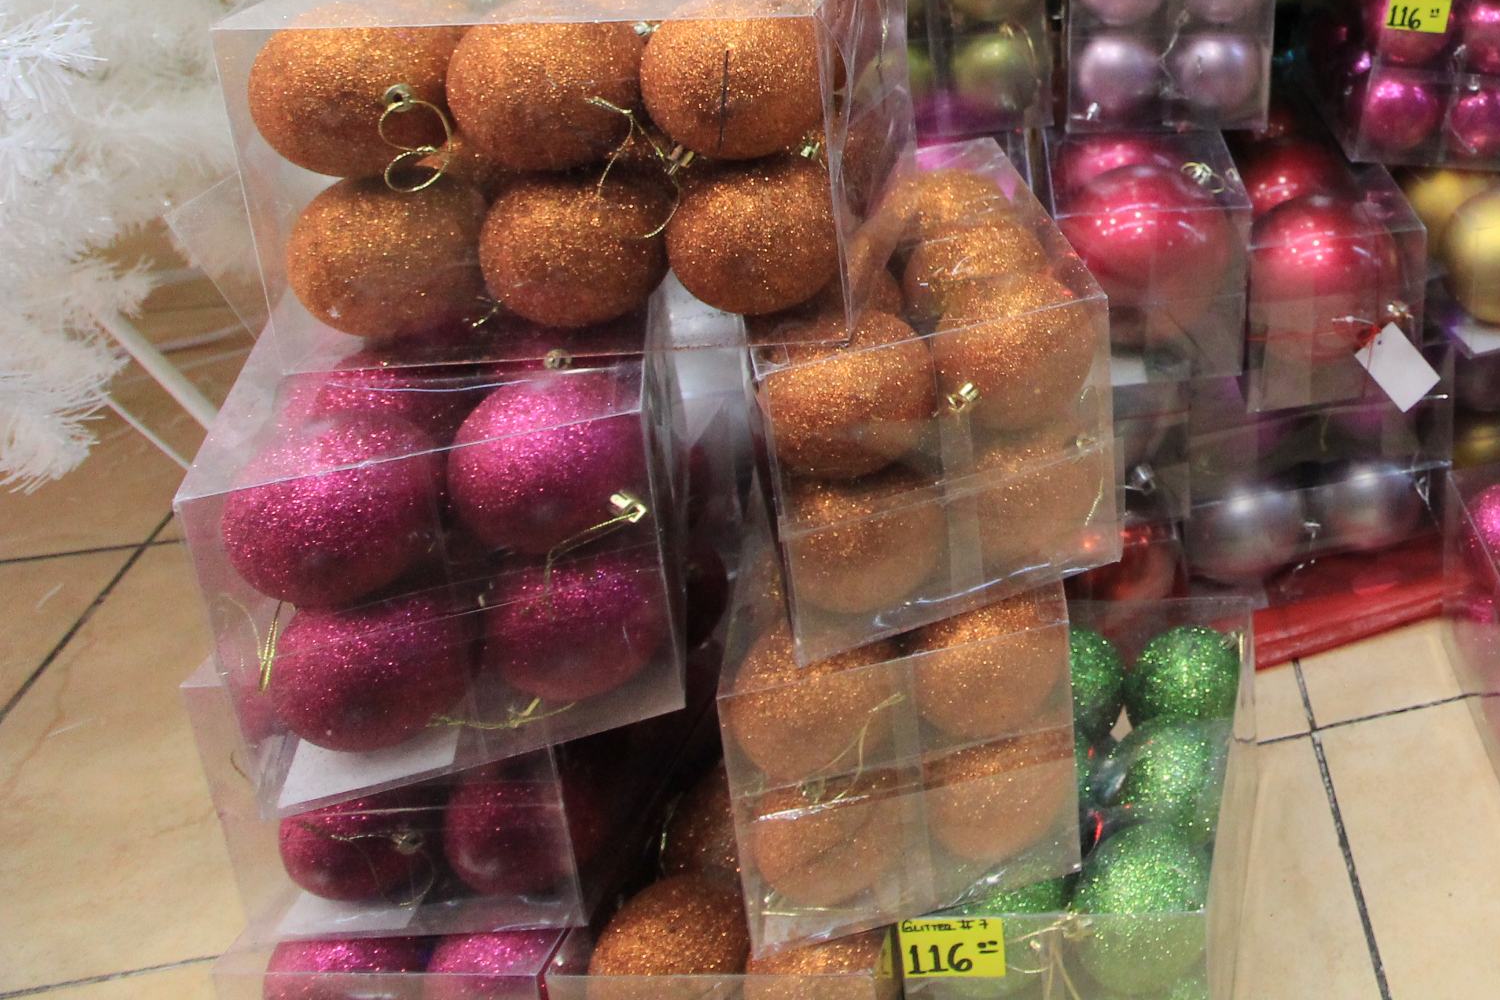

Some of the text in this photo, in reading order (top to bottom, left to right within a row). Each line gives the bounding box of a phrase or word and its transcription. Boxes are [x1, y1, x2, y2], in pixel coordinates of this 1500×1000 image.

[1387, 5, 1421, 29] 116
[902, 919, 956, 933] GLITTER
[907, 943, 973, 974] 116
